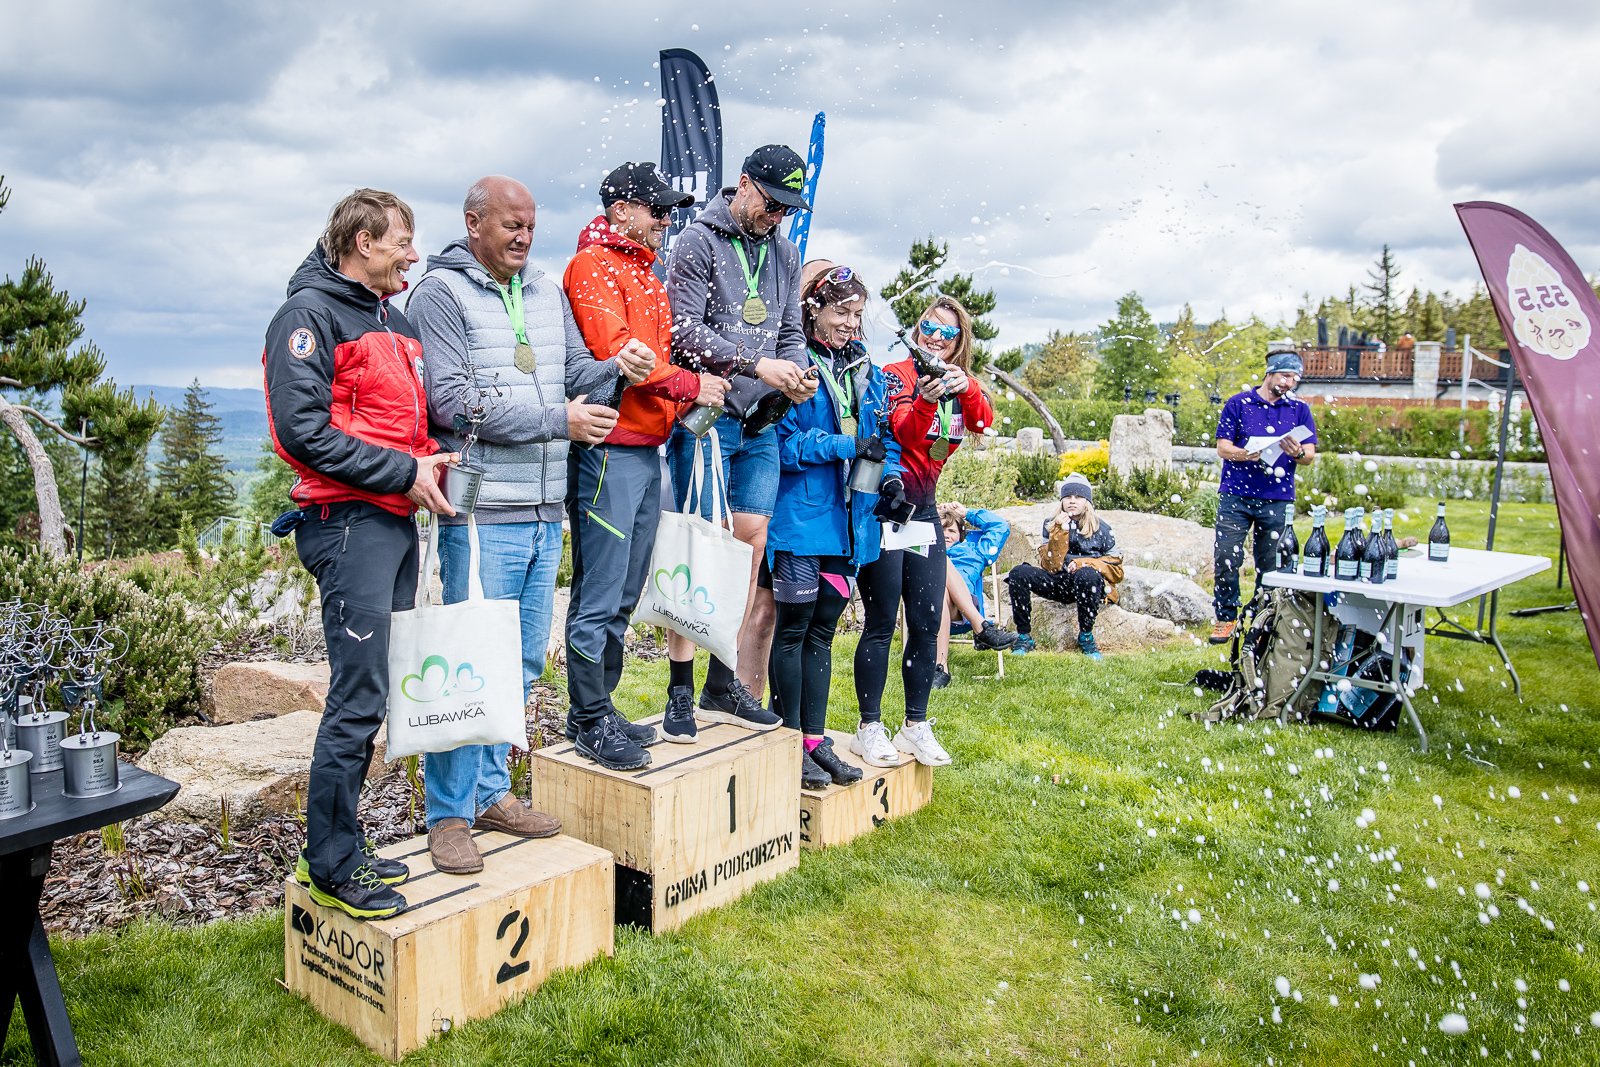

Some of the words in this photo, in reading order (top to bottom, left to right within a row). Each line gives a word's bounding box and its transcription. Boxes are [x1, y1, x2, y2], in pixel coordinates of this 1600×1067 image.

[652, 602, 709, 636] LUBAWKA
[408, 706, 486, 728] LUBAWKA
[464, 700, 485, 708] Gmina
[726, 774, 737, 834] 1
[871, 777, 889, 828] 3
[665, 869, 709, 909] GMINA
[713, 831, 793, 887] PODGORZYN
[302, 939, 337, 970] Packaging
[336, 961, 363, 984] without
[363, 975, 387, 997] limits.
[316, 916, 386, 982] KADOR
[496, 909, 531, 985] 2
[300, 953, 329, 980] Logistics
[329, 972, 356, 996] without
[356, 986, 386, 1014] borders.
